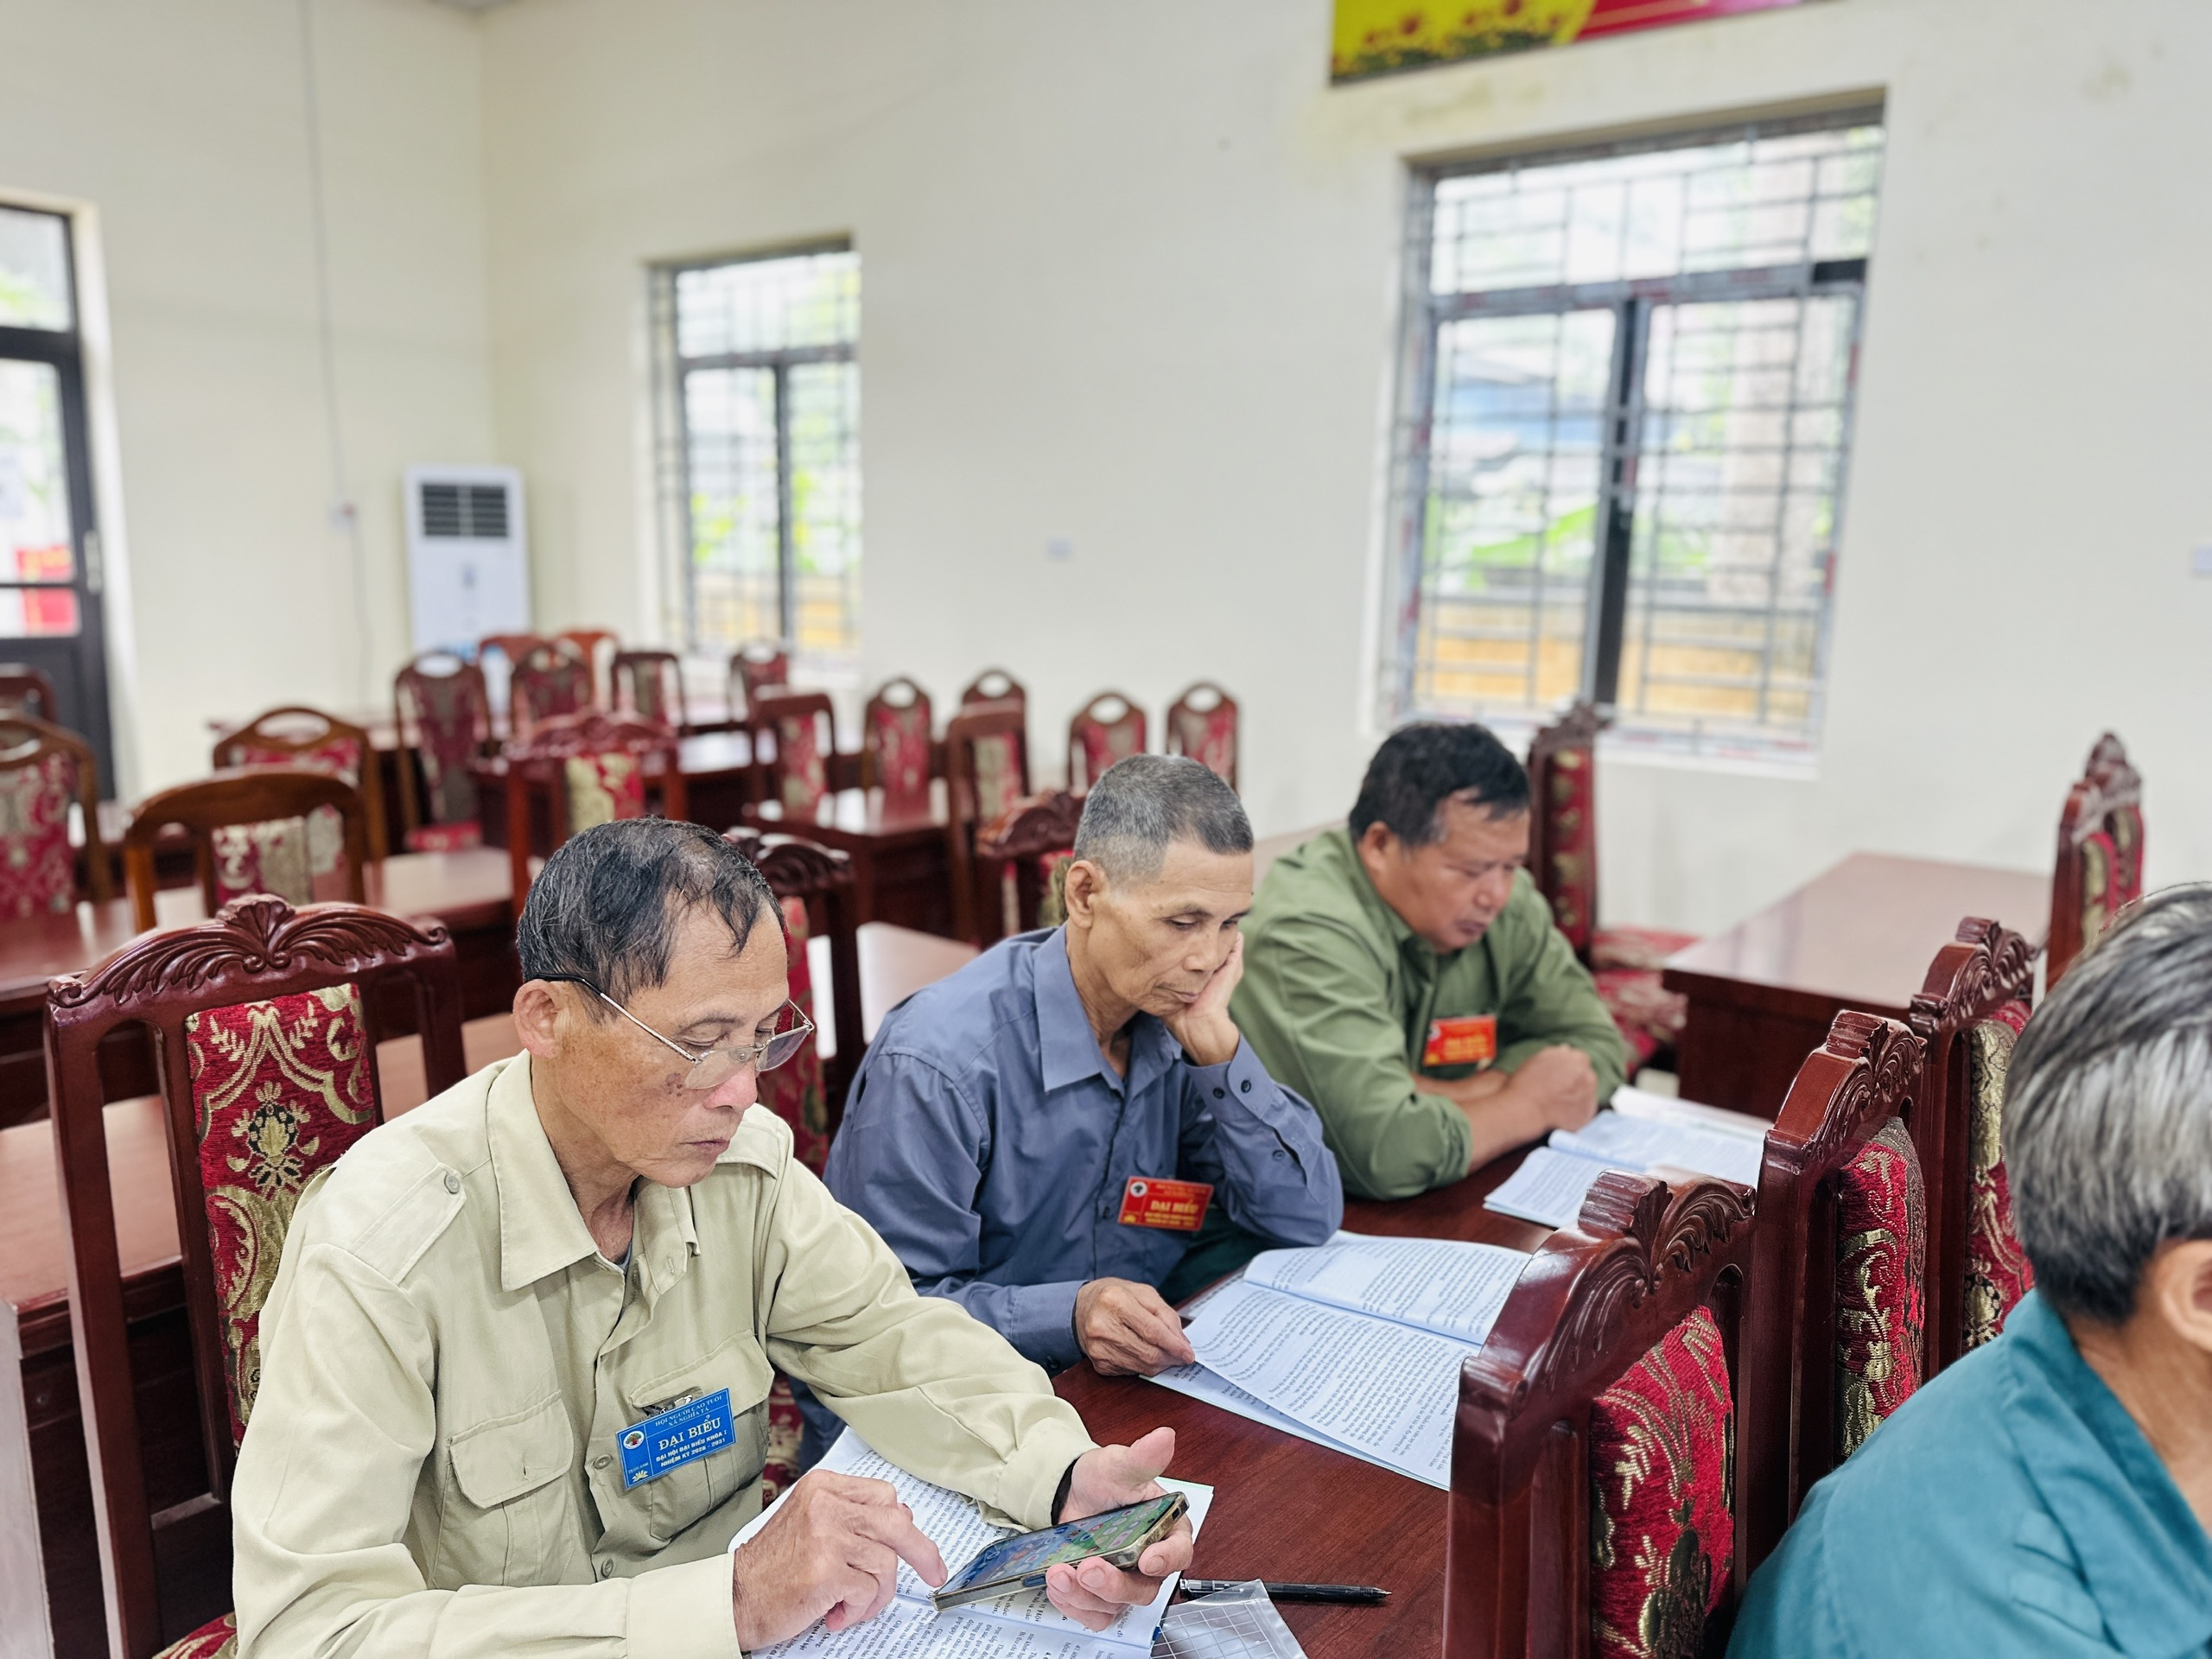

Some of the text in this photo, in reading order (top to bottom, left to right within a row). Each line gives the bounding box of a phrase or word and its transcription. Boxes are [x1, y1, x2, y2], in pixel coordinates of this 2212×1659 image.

[658, 1414, 721, 1450] ĐẠI BIỂU
[656, 1453, 667, 1462] ĐẠI
[691, 1438, 705, 1446] BIỂU
[706, 1433, 722, 1441] KHÓA
[660, 1456, 681, 1467] NHIỆM
